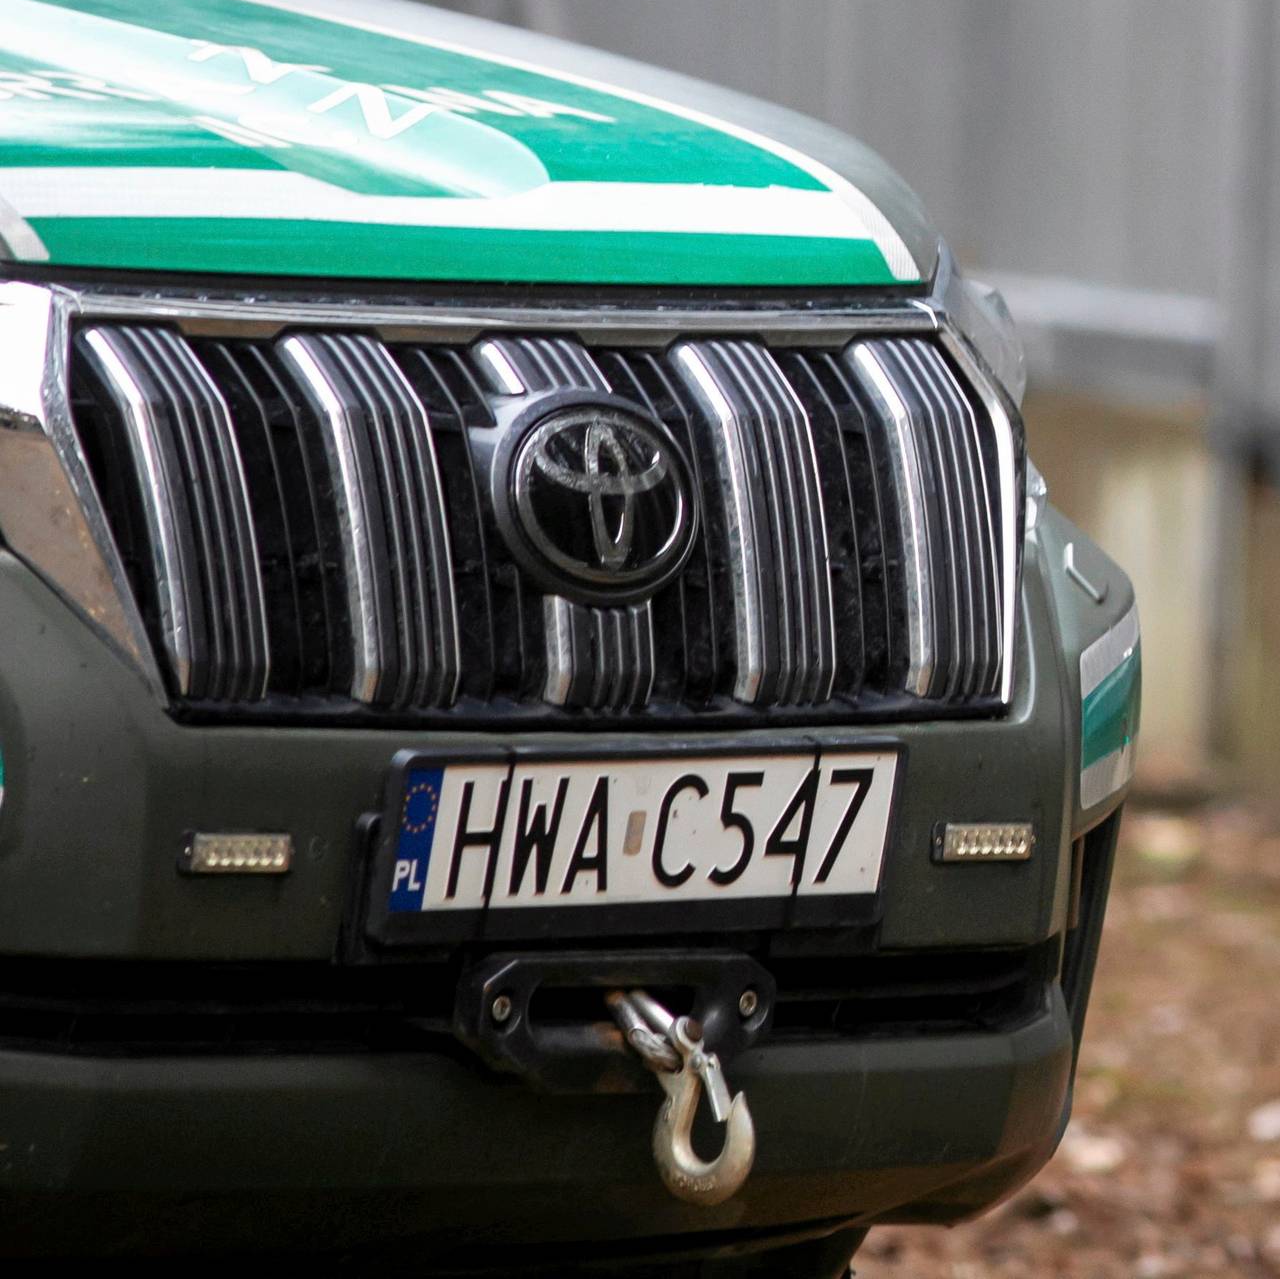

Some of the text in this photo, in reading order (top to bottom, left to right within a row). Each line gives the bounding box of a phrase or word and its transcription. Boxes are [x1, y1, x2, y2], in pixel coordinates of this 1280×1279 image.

[445, 768, 874, 899] HWA C547
[391, 858, 421, 892] PL
